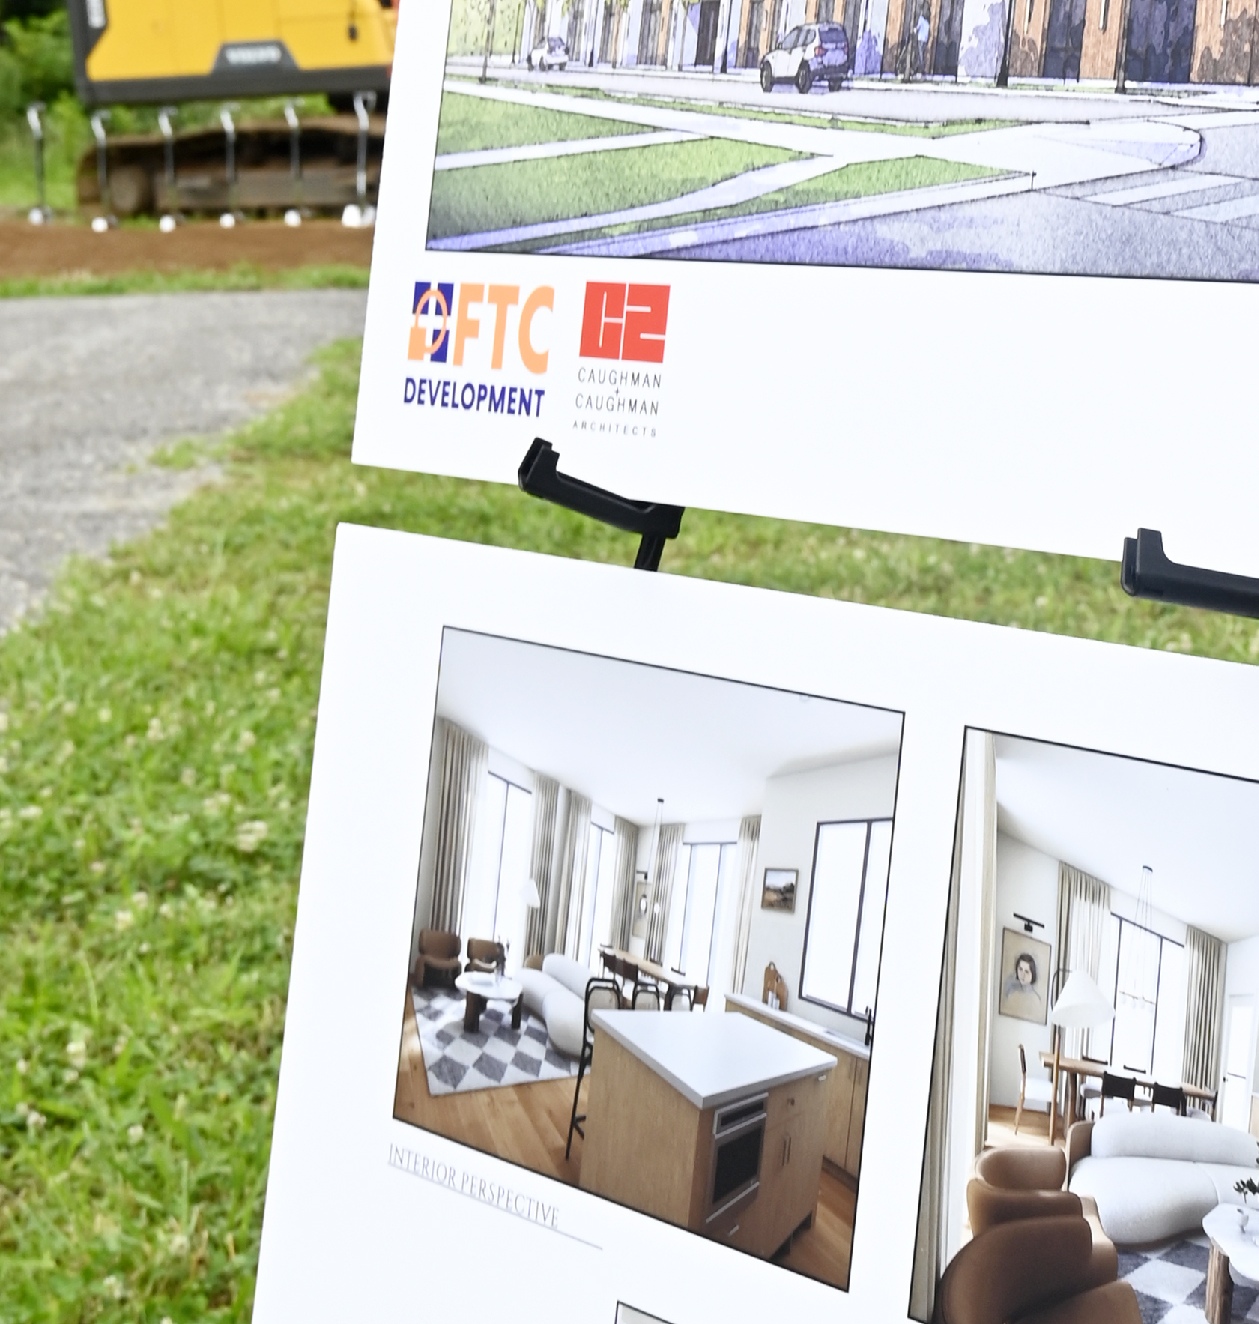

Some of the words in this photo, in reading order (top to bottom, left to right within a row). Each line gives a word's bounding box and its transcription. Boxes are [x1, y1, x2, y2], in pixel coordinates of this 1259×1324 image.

[453, 282, 555, 375] FTC
[577, 367, 662, 389] CAUGHMAN
[403, 377, 546, 418] DEVELOPMENT
[574, 393, 660, 416] CAUGHMAN
[572, 420, 658, 438] ARCHITECTS
[388, 1142, 457, 1190] INTERIOR
[459, 1172, 560, 1229] PERSPECTIVE
